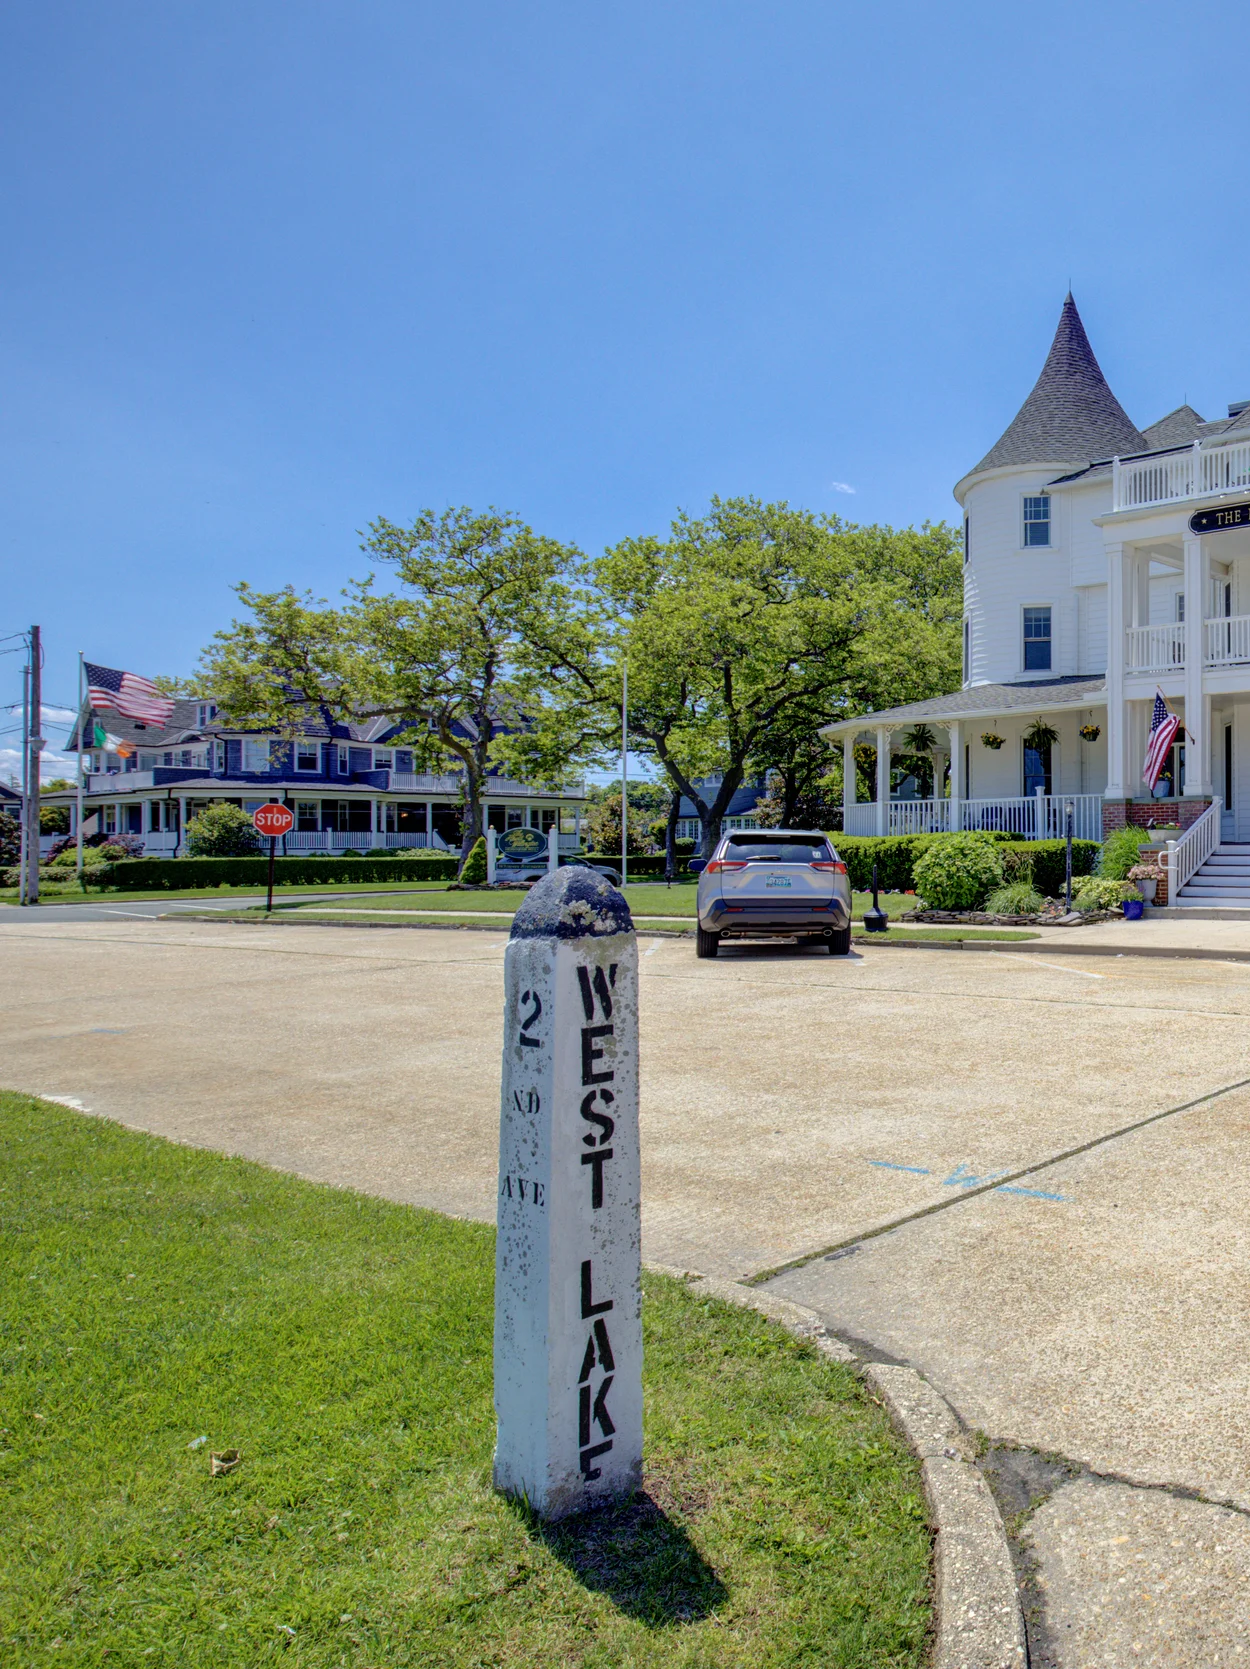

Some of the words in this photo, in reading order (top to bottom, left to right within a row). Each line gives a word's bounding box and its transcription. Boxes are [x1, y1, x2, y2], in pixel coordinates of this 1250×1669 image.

[1215, 509, 1242, 526] THE
[256, 813, 291, 826] STOP
[519, 988, 543, 1049] 2
[576, 963, 616, 1210] WEST
[512, 1089, 541, 1115] ND
[501, 1174, 545, 1207] AVE
